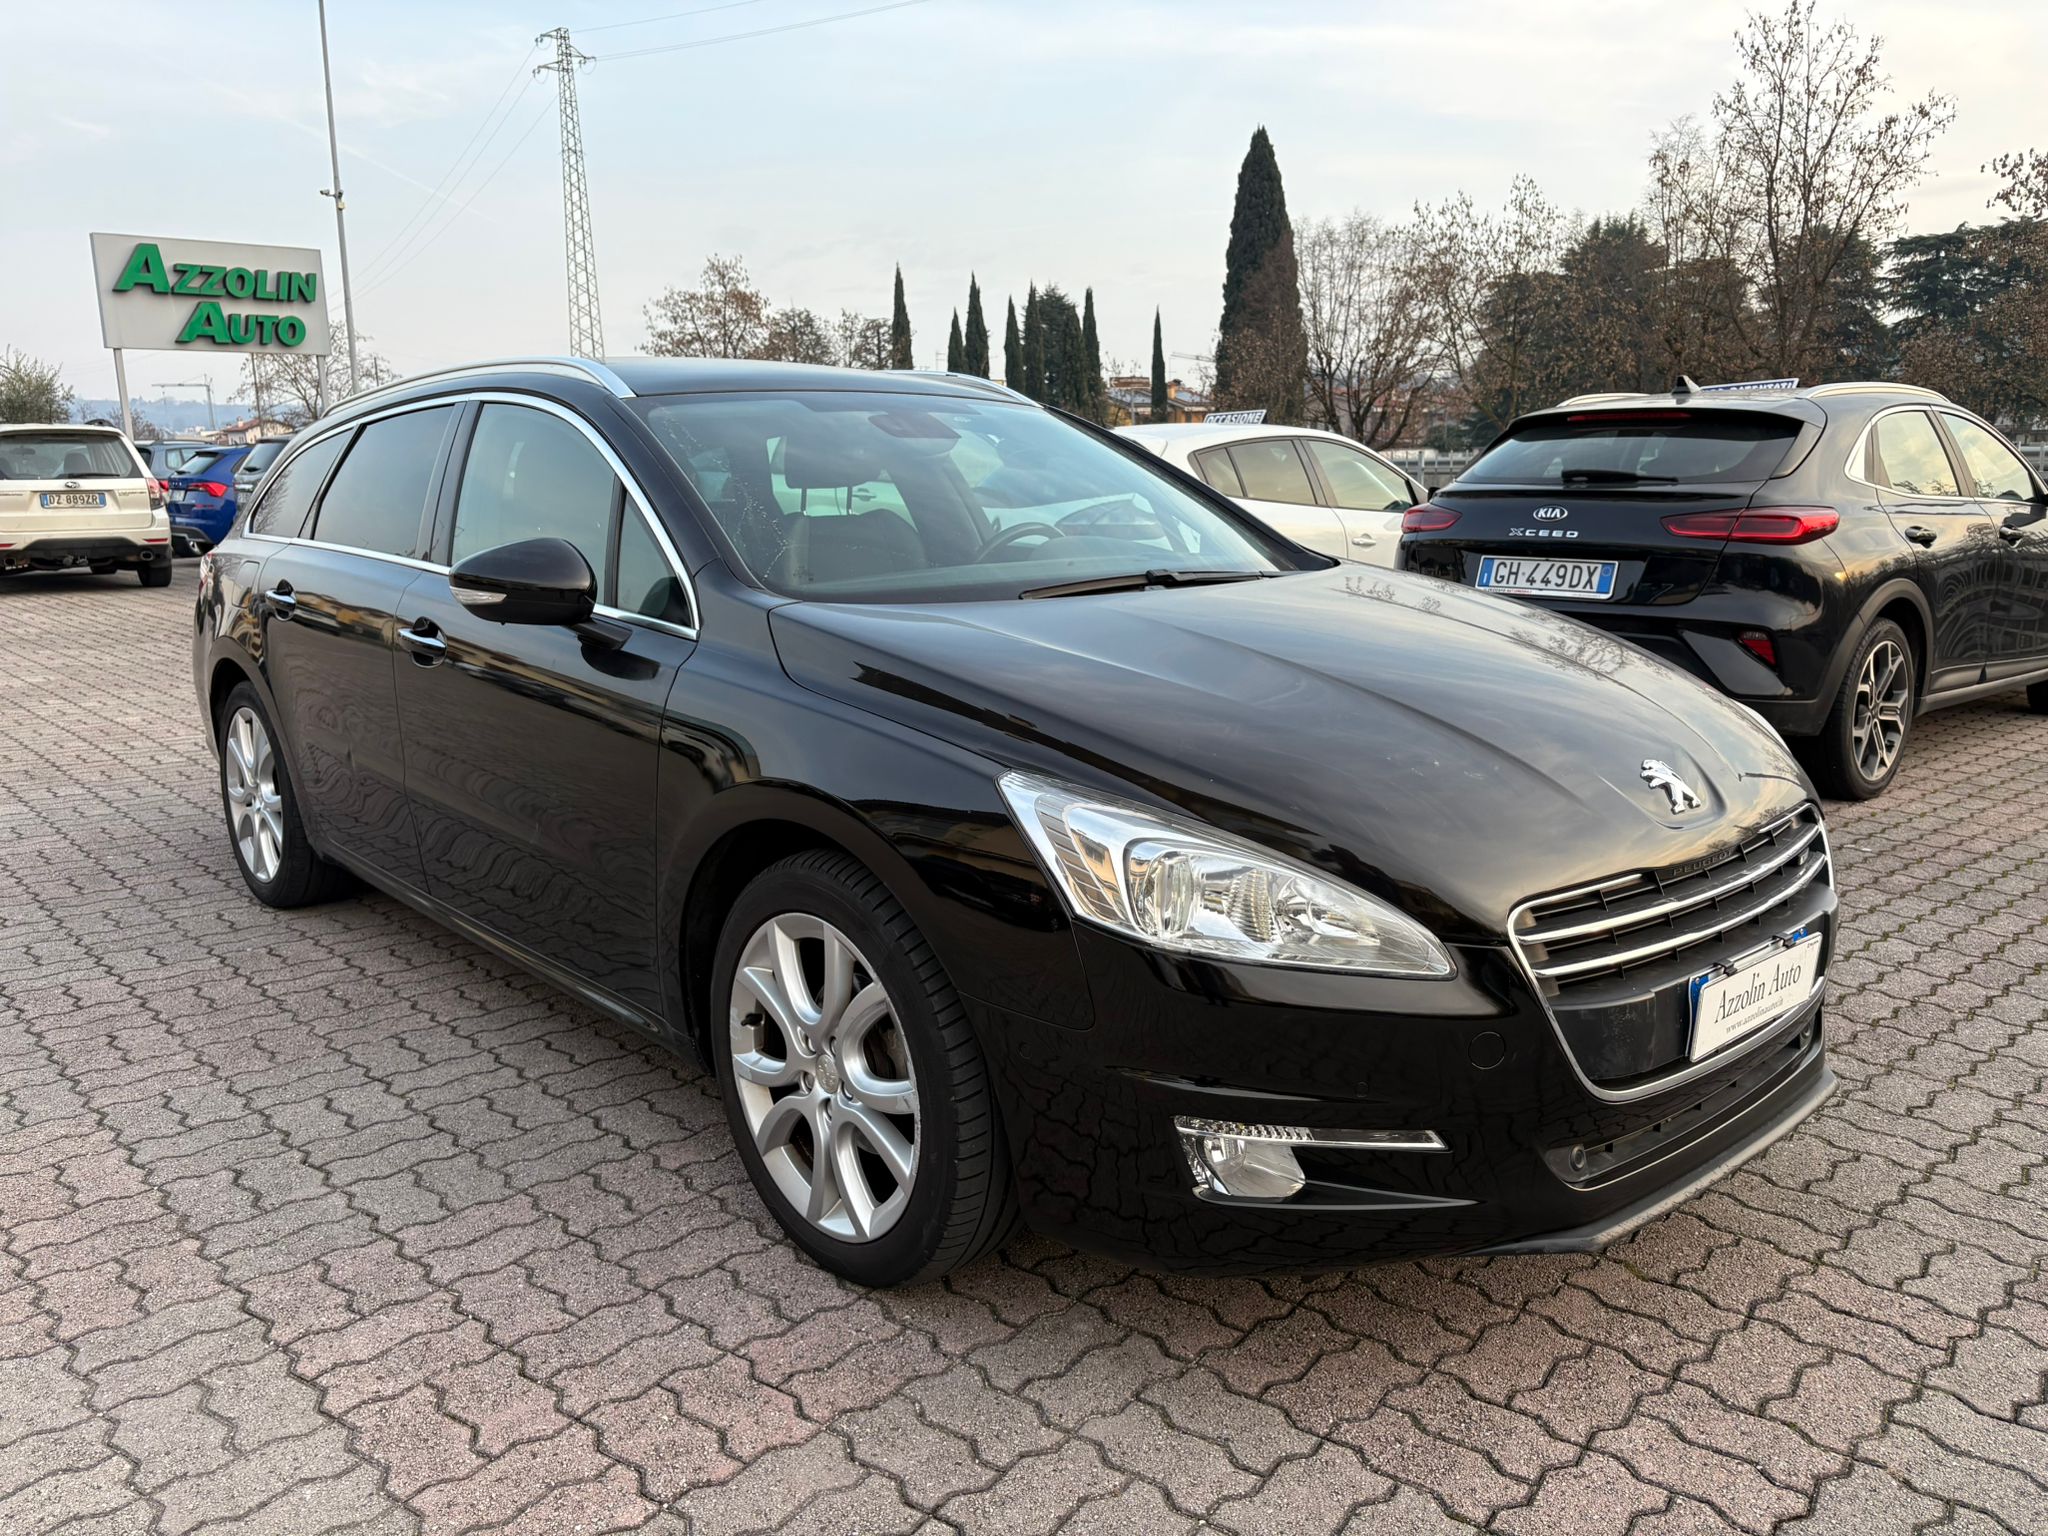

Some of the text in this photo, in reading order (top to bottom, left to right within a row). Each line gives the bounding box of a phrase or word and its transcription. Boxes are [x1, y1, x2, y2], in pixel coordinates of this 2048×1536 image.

[113, 242, 317, 302] AZZOLIN
[175, 301, 306, 347] AUTO
[1206, 412, 1262, 424] OCCASIONE
[1537, 507, 1561, 518] KIA
[1508, 527, 1579, 538] XCEED
[1673, 848, 1733, 876] PEUGEOT
[1714, 963, 1802, 1024] Azzolin Auto
